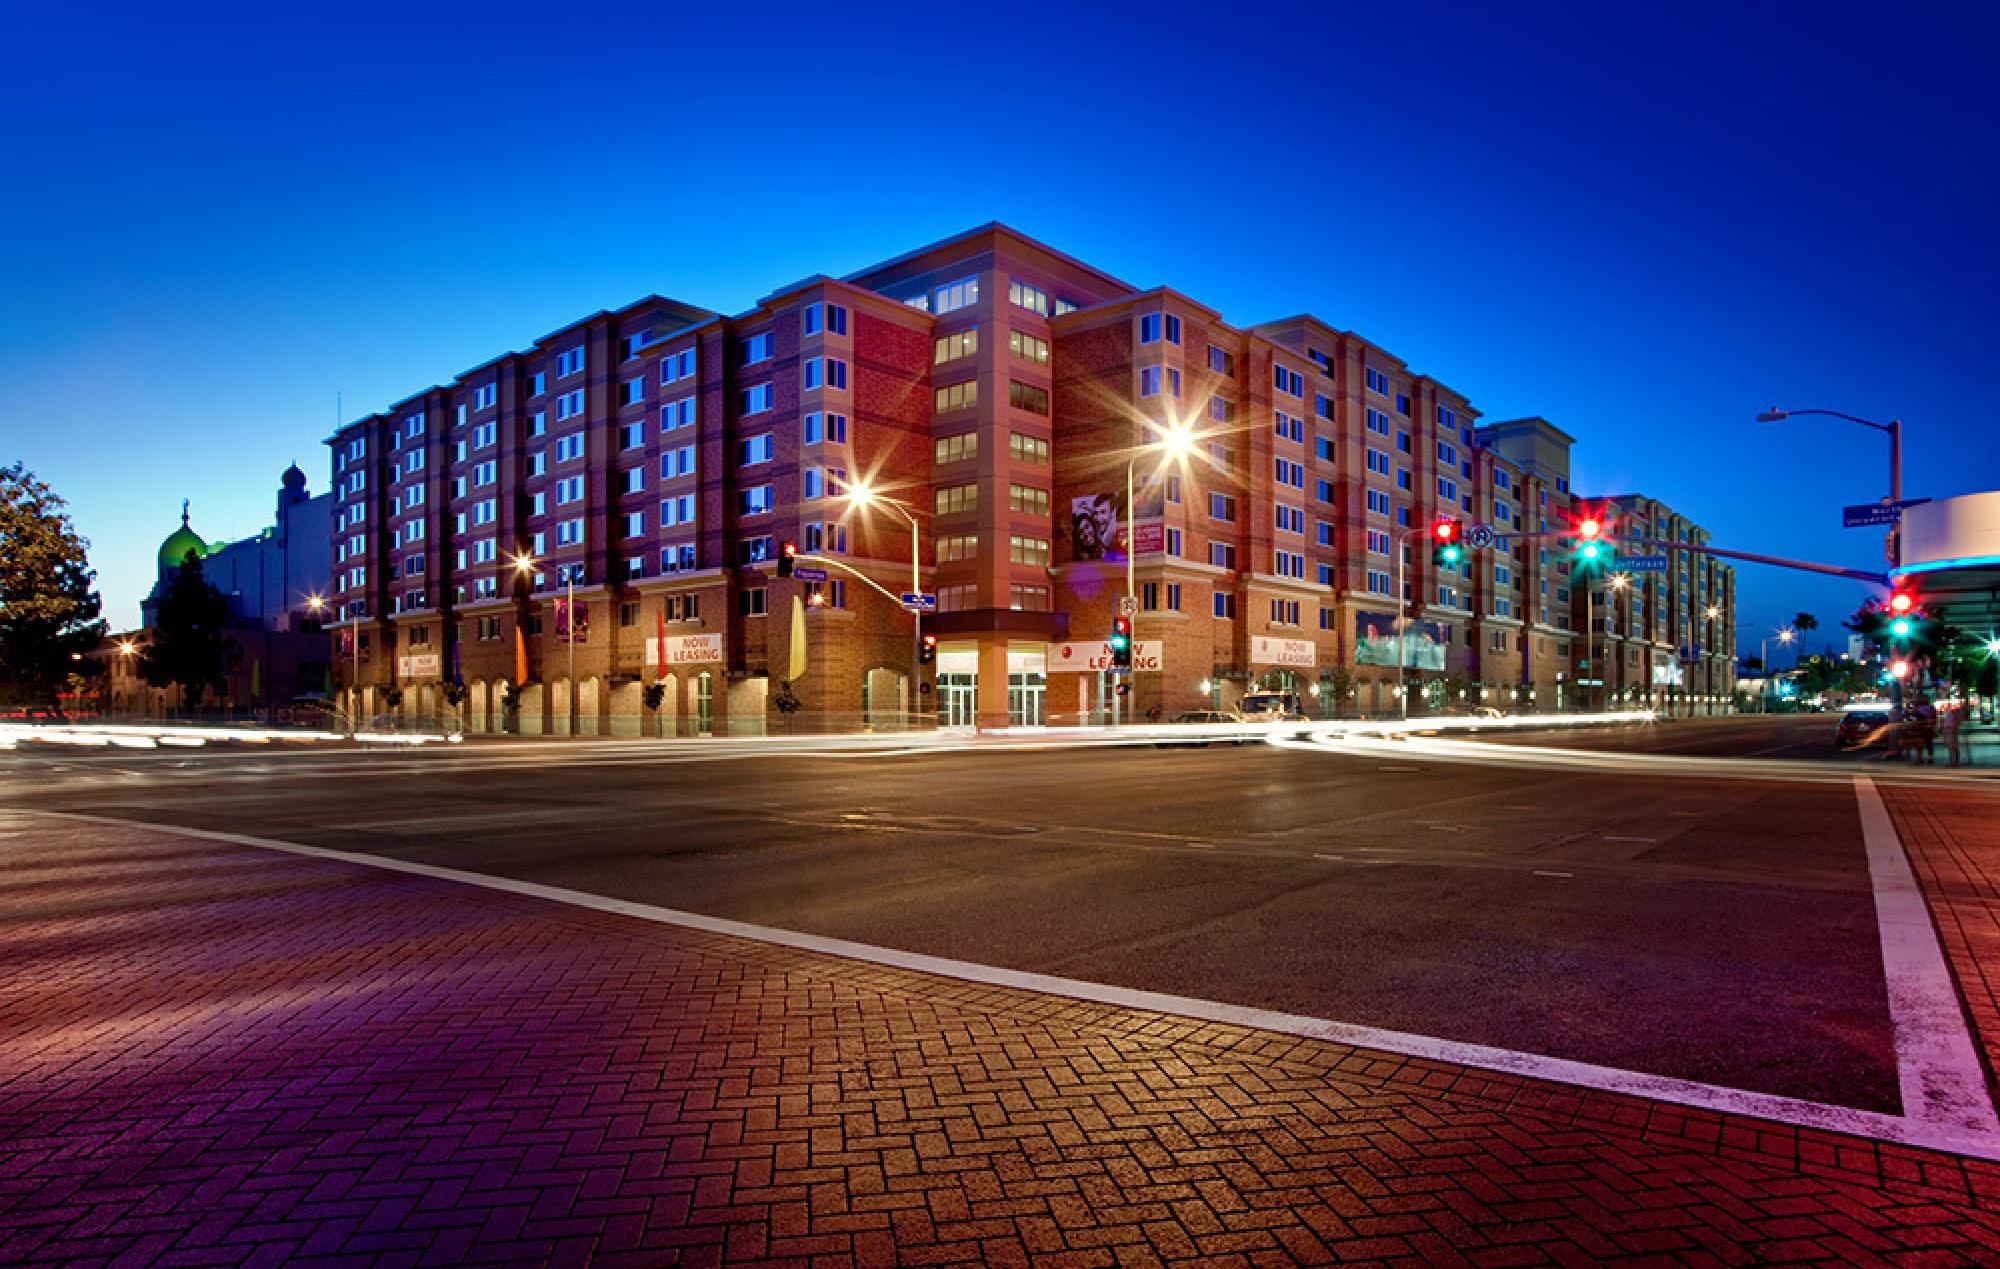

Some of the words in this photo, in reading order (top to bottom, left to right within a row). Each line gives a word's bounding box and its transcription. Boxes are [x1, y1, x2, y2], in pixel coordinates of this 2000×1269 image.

[1614, 560, 1665, 568] Jefferson
[683, 638, 708, 648] NOW
[673, 648, 719, 662] LEASING
[1103, 644, 1144, 655] NW
[1088, 657, 1157, 669] LEANG
